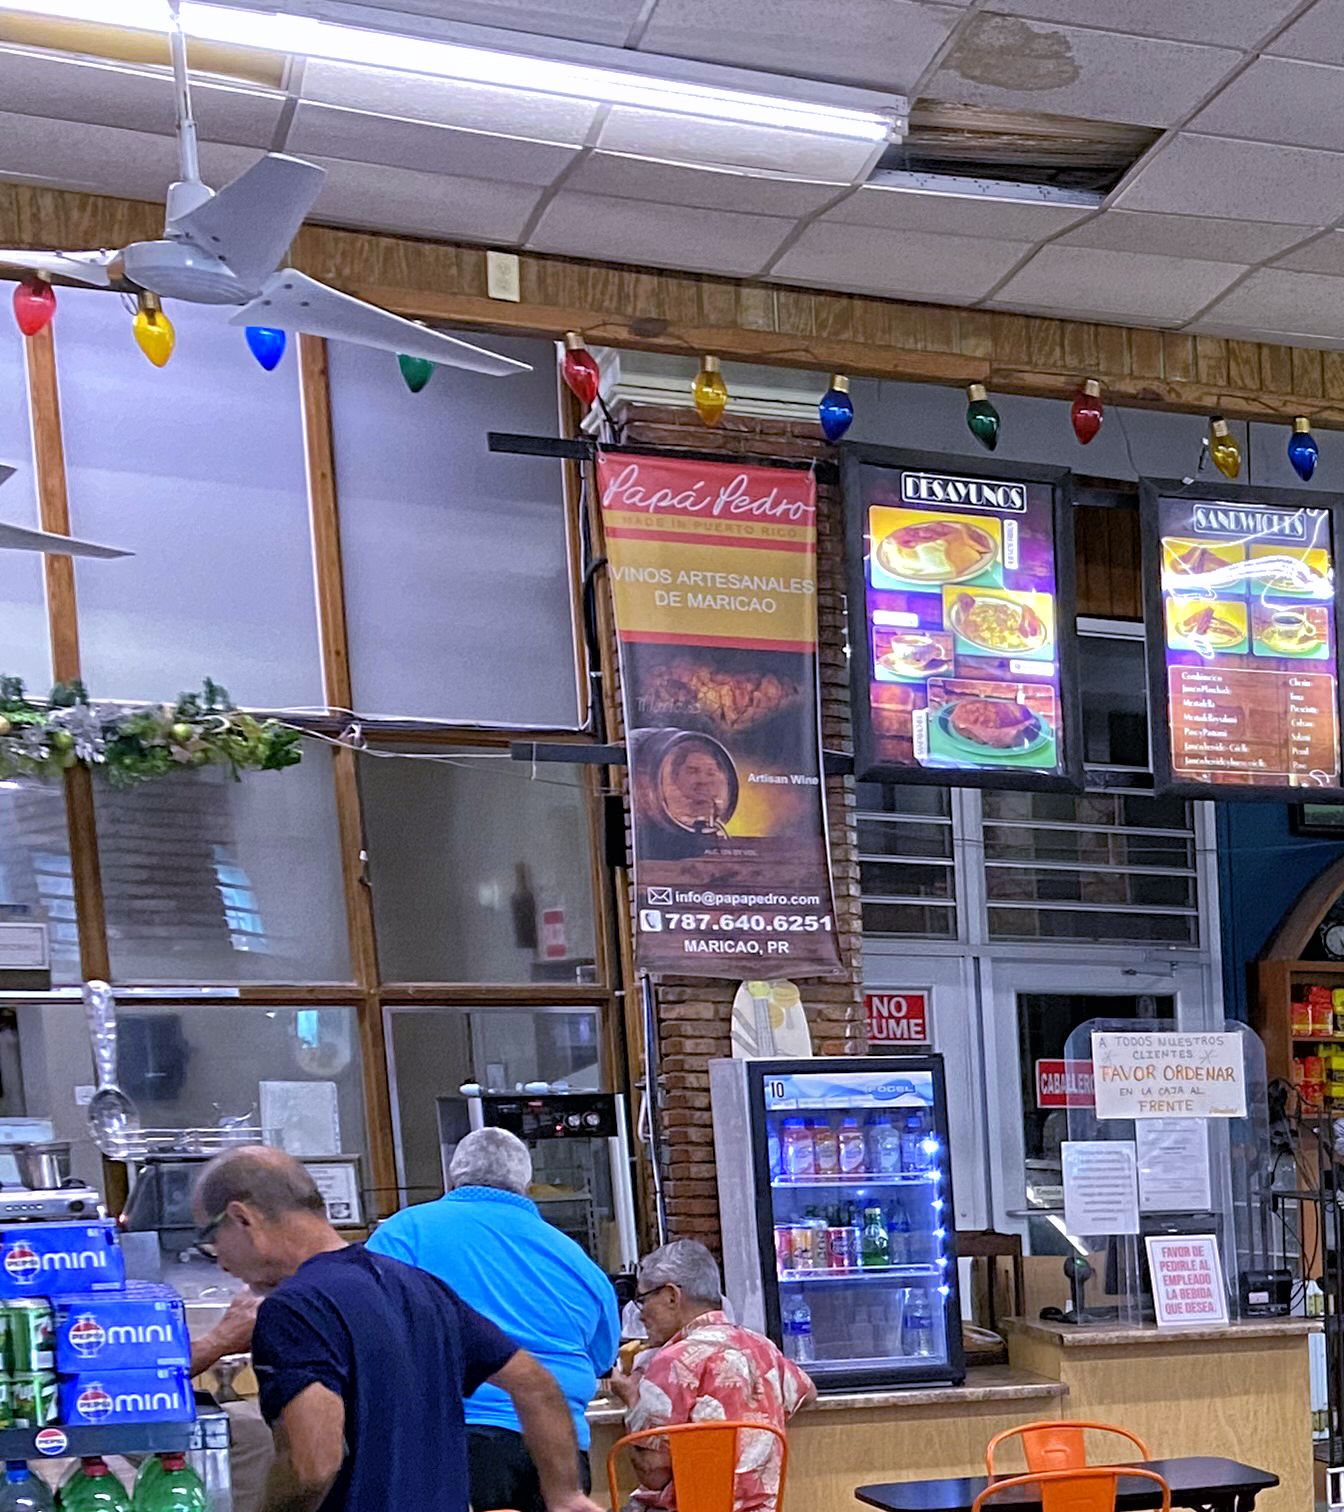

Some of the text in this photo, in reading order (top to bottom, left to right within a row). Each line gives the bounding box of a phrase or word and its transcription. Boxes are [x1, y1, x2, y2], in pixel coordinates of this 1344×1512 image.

[602, 465, 813, 520] Papá Pedro
[905, 477, 1022, 509] DESAYUNOS
[694, 520, 755, 535] PUERTO
[761, 525, 797, 538] RICO
[1195, 508, 1304, 535] SANDWICHES
[612, 567, 814, 594] VINOS ARTESANALES
[655, 591, 776, 613] DE MARICAO
[747, 772, 819, 785] Artisan Wine
[675, 890, 819, 906] info@papapedro.com
[666, 912, 832, 932] 787.640.6251
[684, 940, 789, 955] MARICAO, PR
[873, 997, 906, 1016] NO
[1099, 1036, 1224, 1047] A TODOS NUESTROS
[1133, 1050, 1193, 1060] CLIENTES
[1101, 1064, 1235, 1082] FAVOR ORDENAR
[1120, 1087, 1204, 1096] EN LA CAJA AL
[1139, 1100, 1193, 1112] FRENTE
[1161, 1246, 1204, 1257] FAVOR DE
[43, 1251, 107, 1270] mini
[1160, 1260, 1210, 1272] PEDIRLE AL
[1163, 1274, 1211, 1286] EMPLEADO
[1166, 1288, 1212, 1301] LA BEBIDA
[1165, 1302, 1216, 1314] QUE DESEA.
[108, 1325, 172, 1344] mini
[115, 1392, 179, 1412] mini
